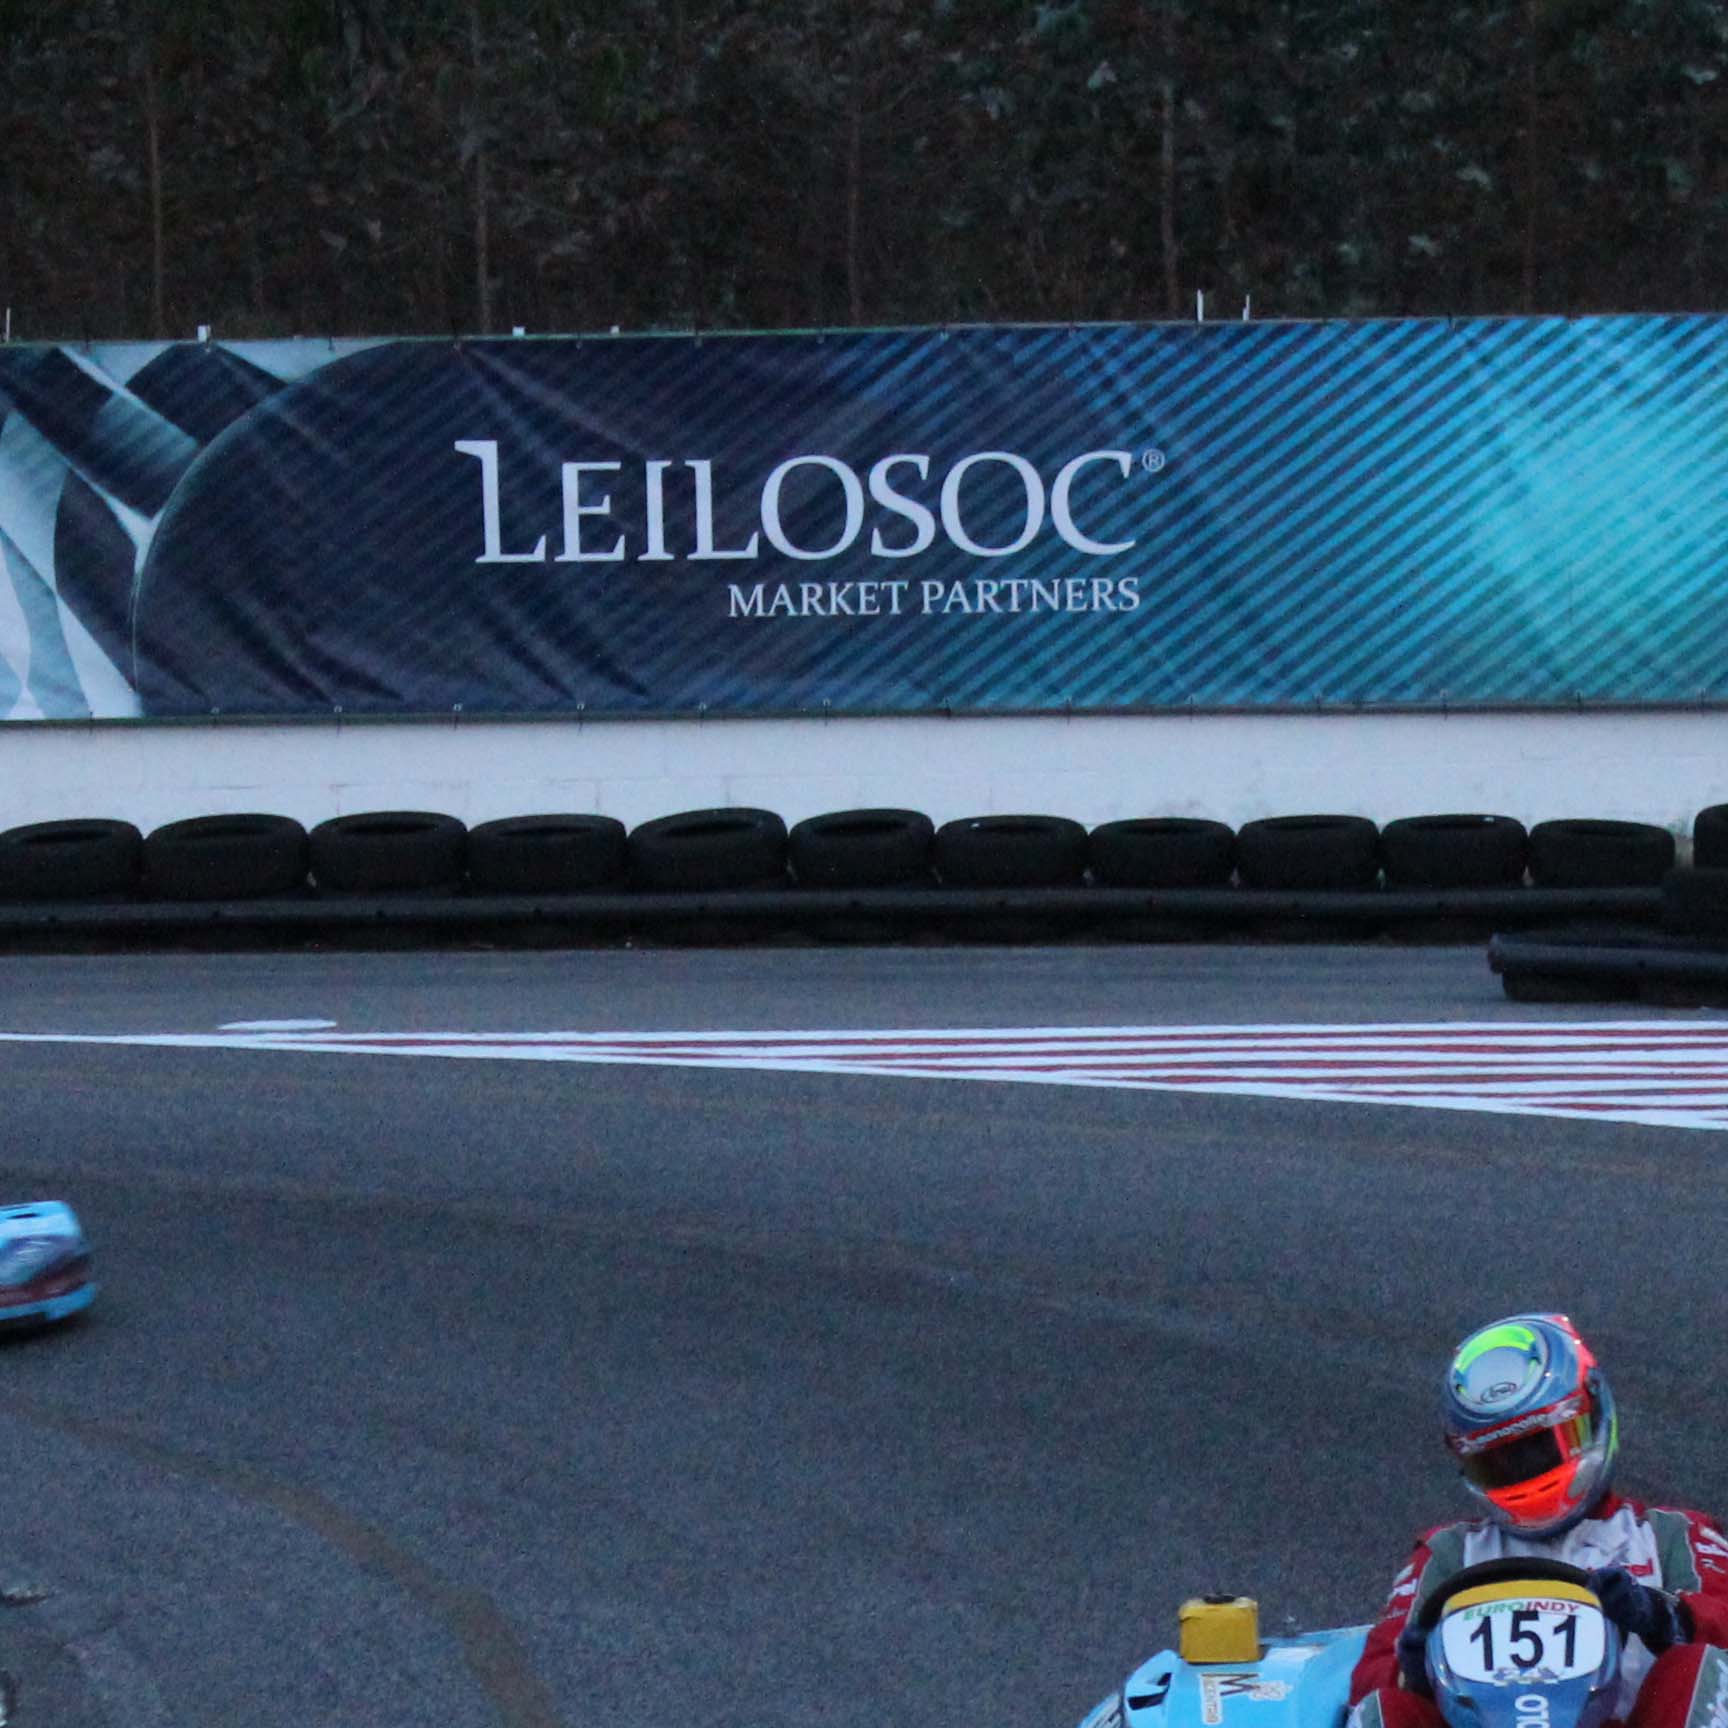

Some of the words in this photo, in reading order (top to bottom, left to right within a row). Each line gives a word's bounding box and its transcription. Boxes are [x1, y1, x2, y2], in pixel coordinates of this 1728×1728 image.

[727, 580, 909, 618] MARKET
[920, 577, 1141, 616] PARTNERS
[1470, 1610, 1577, 1671] 151
